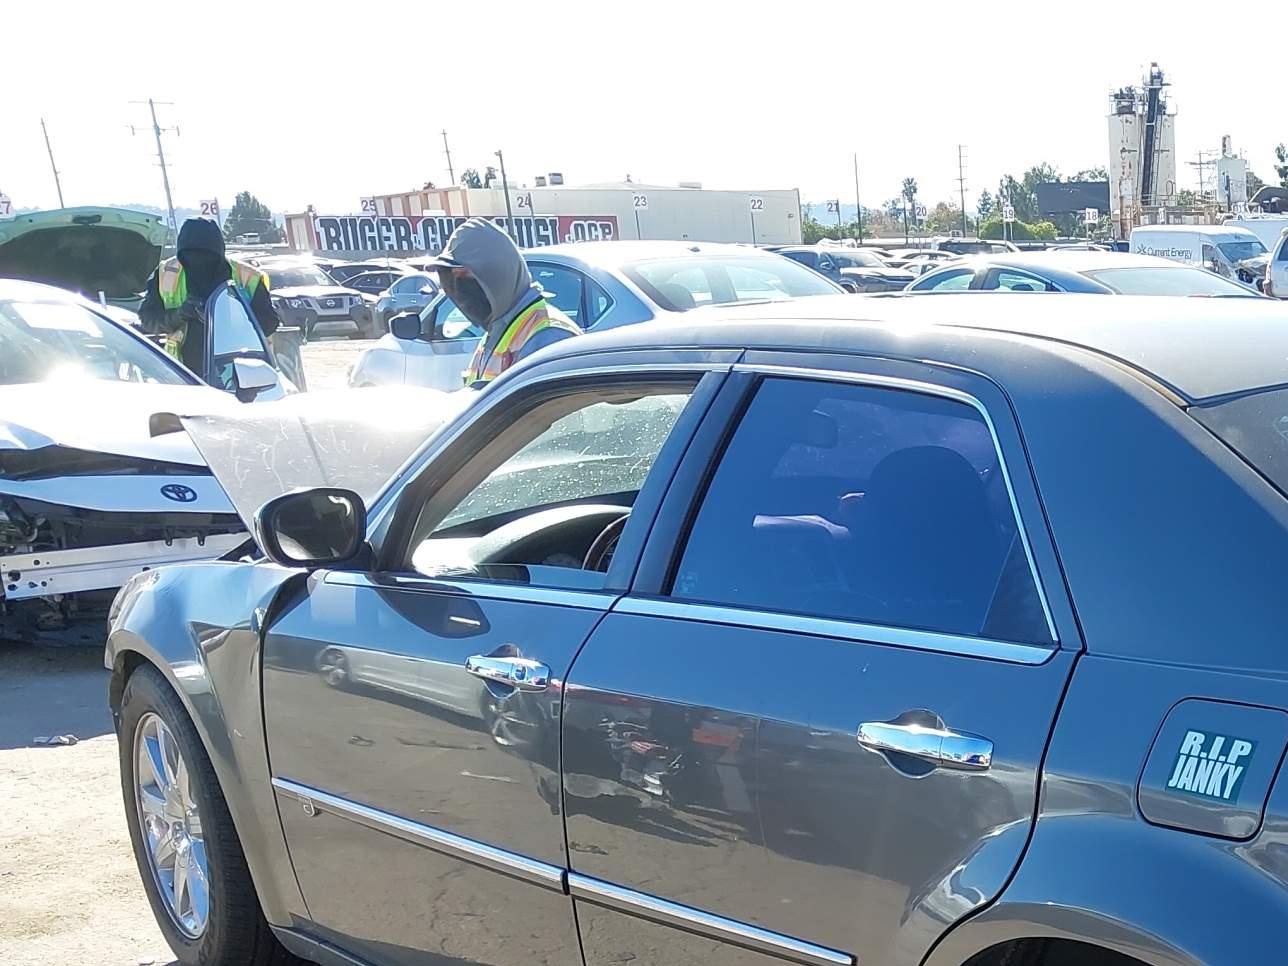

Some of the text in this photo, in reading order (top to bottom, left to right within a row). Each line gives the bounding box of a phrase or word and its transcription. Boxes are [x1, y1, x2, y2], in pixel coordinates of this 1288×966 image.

[361, 199, 377, 212] 25
[517, 196, 532, 208] 24
[633, 196, 647, 207] 23
[751, 199, 763, 210] 22
[200, 202, 218, 216] 26
[915, 206, 927, 217] 20
[1003, 206, 1014, 218] 19
[1086, 211, 1098, 221] 18
[1147, 246, 1193, 259] Current Energy
[1179, 730, 1253, 765] R.I.P
[1168, 754, 1245, 800] JANKY
